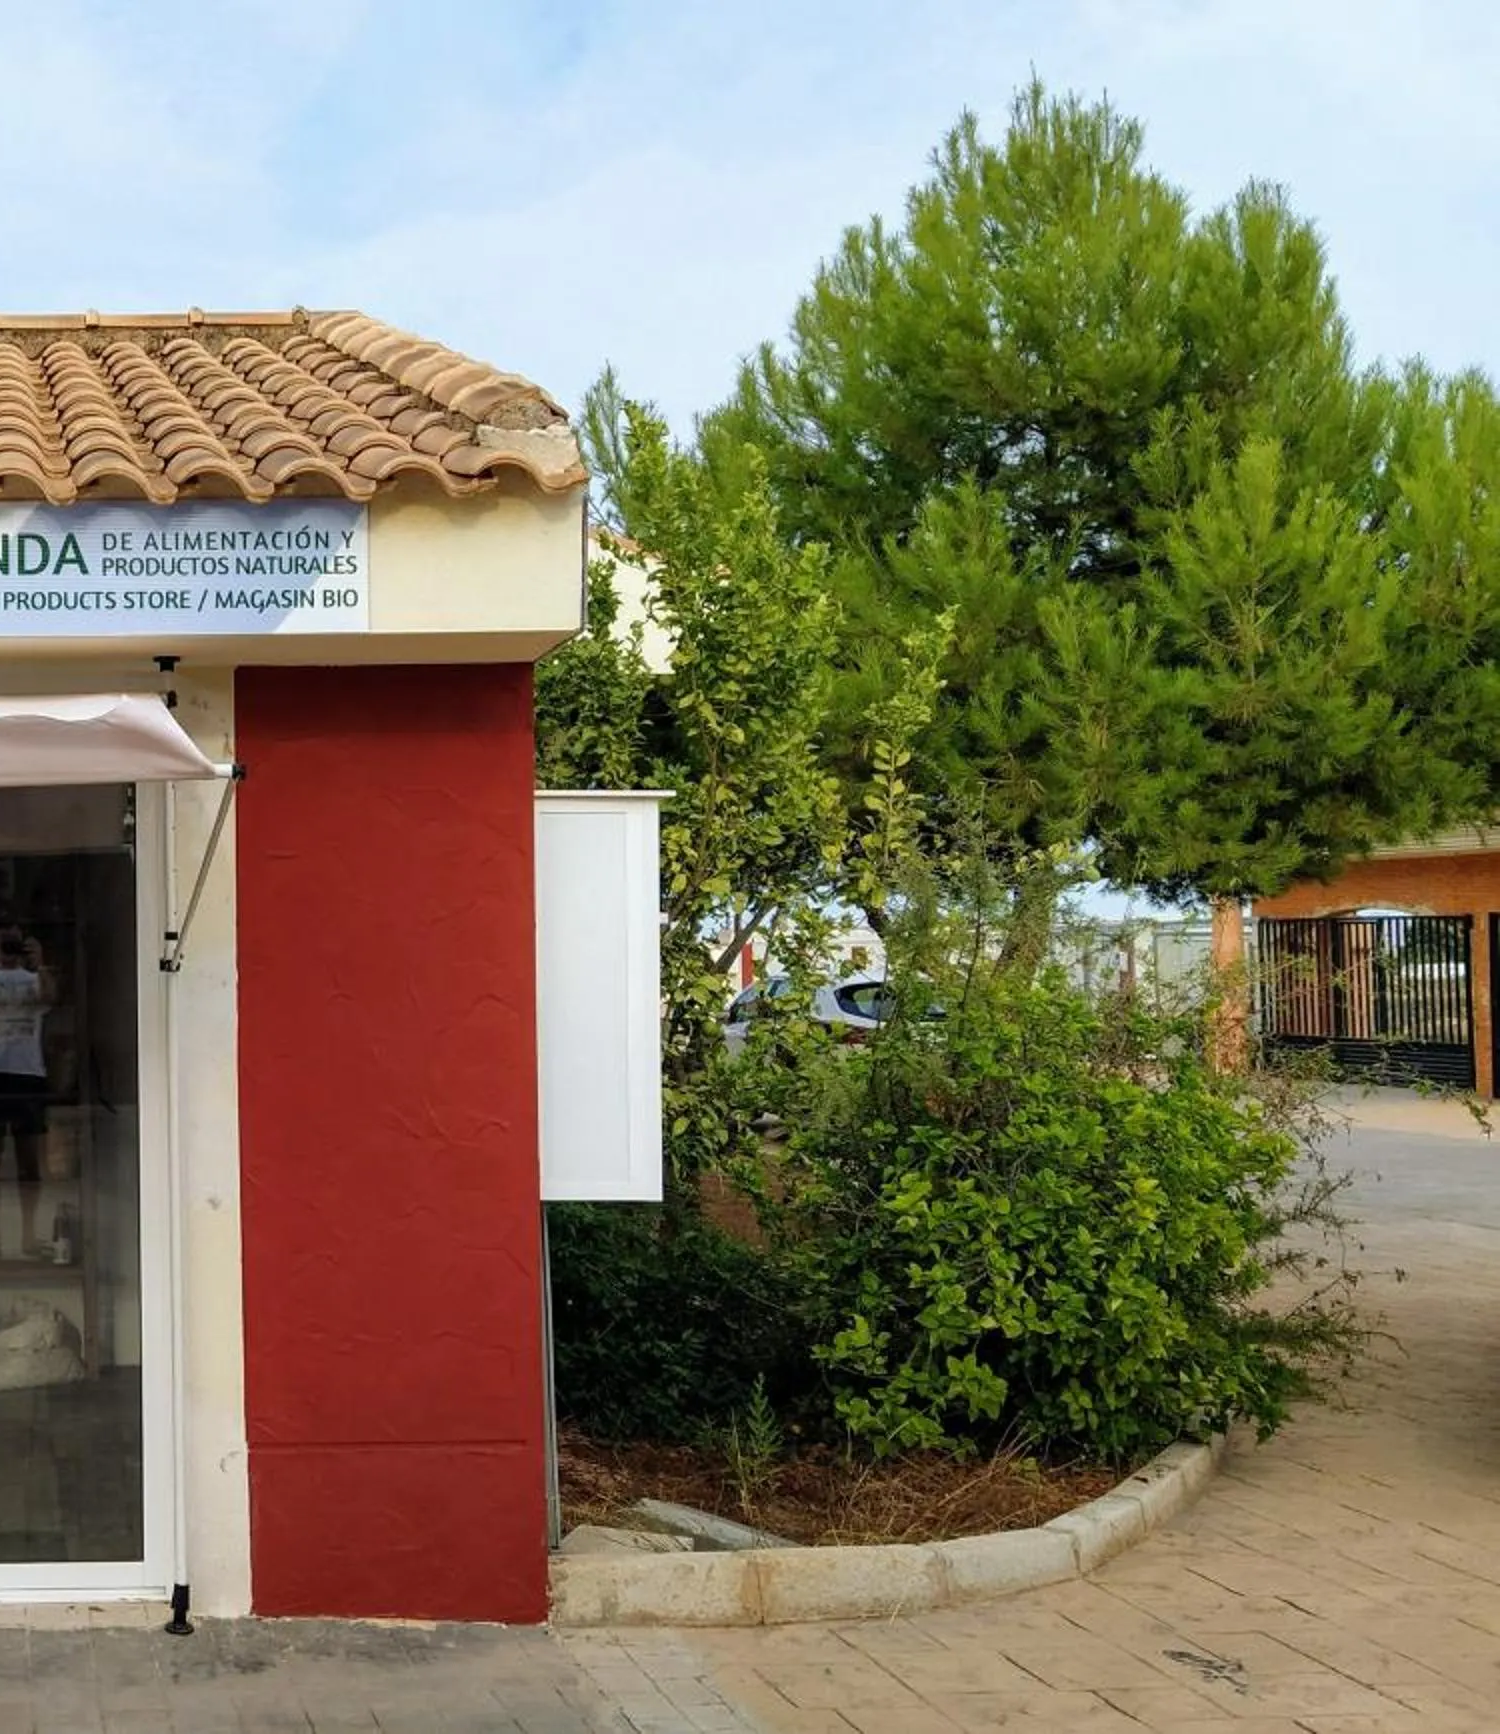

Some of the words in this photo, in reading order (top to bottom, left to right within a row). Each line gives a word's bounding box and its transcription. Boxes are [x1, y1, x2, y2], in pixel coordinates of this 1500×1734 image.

[103, 532, 133, 551] DE
[144, 525, 330, 551] ALIMENTACIÓN
[341, 530, 355, 549] Y
[102, 557, 230, 576] PRODUCTOS
[235, 555, 358, 575] NATURALES
[3, 591, 117, 610] PRODUCTS
[123, 590, 192, 609] STORE
[322, 589, 359, 608] BIO
